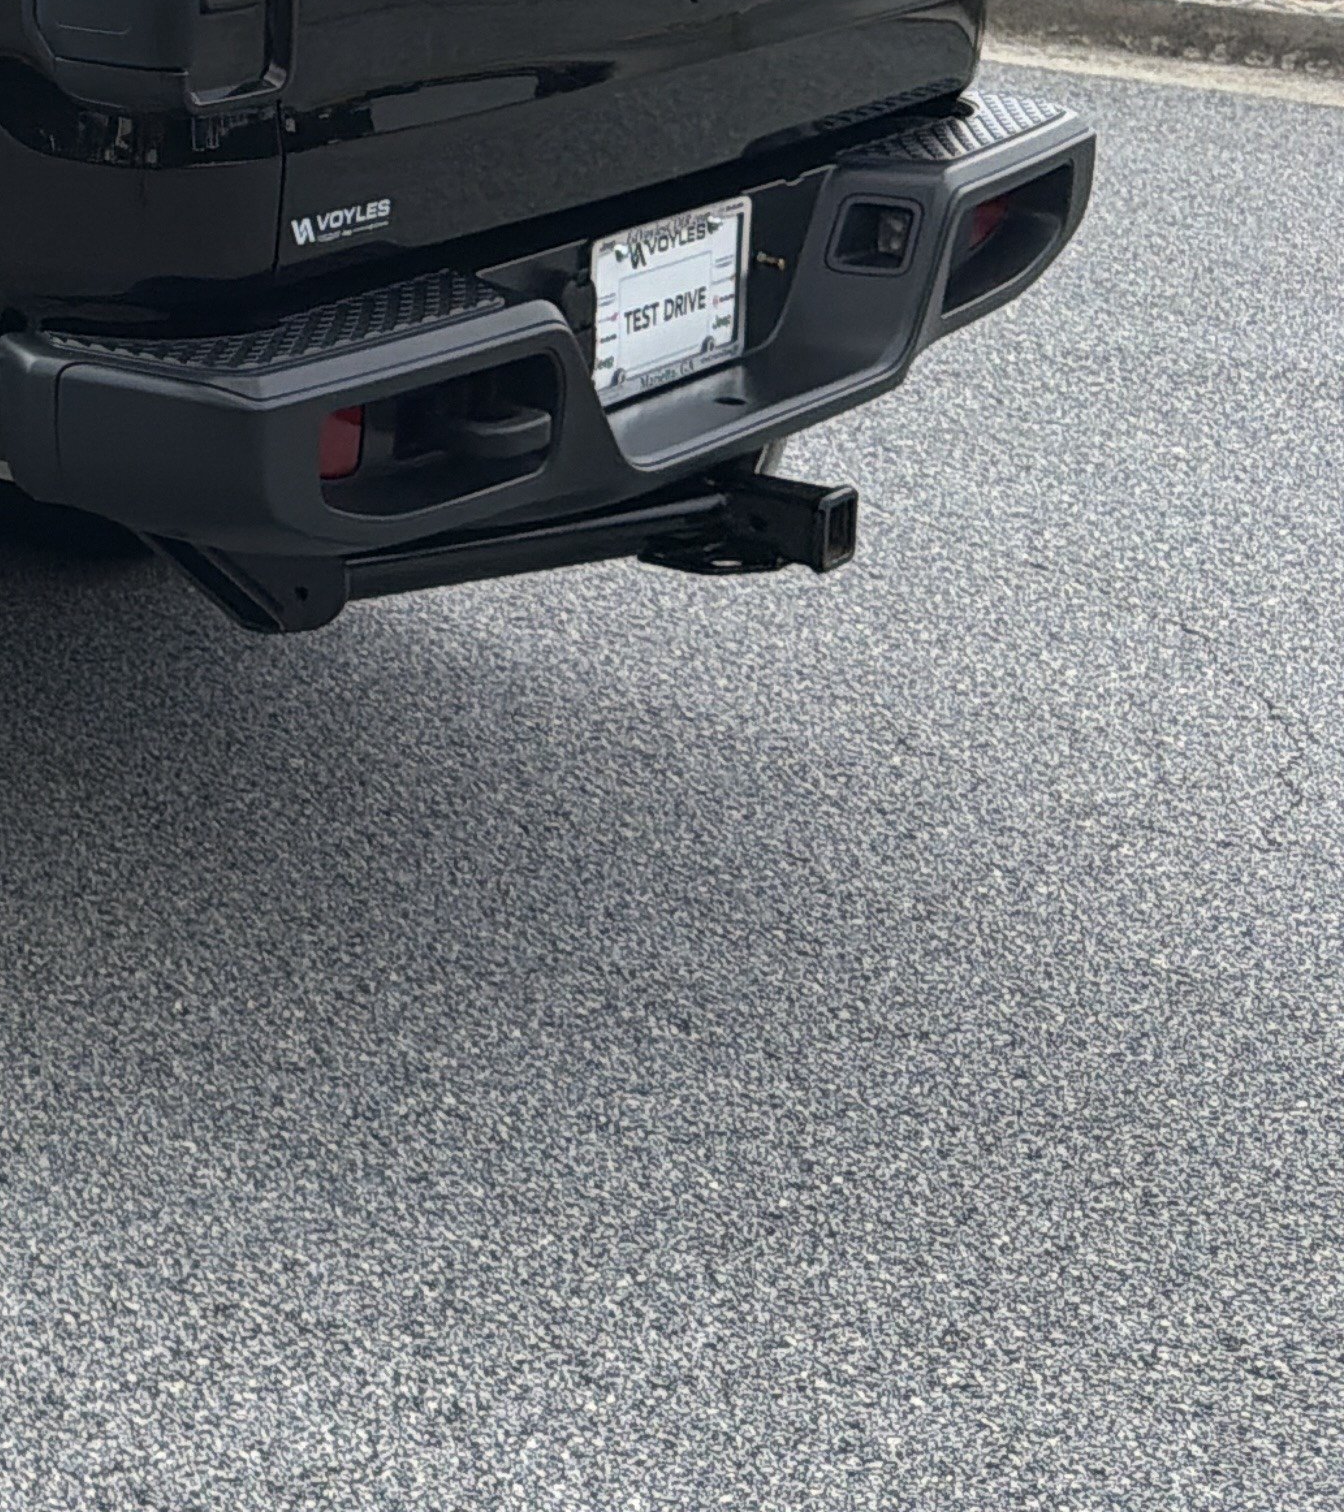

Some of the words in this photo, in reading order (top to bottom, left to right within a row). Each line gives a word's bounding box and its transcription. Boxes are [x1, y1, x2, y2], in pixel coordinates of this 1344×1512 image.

[316, 198, 391, 231] VOYLES
[644, 223, 706, 255] VOYLES
[624, 301, 660, 335] TEST
[663, 286, 707, 322] DRIVE
